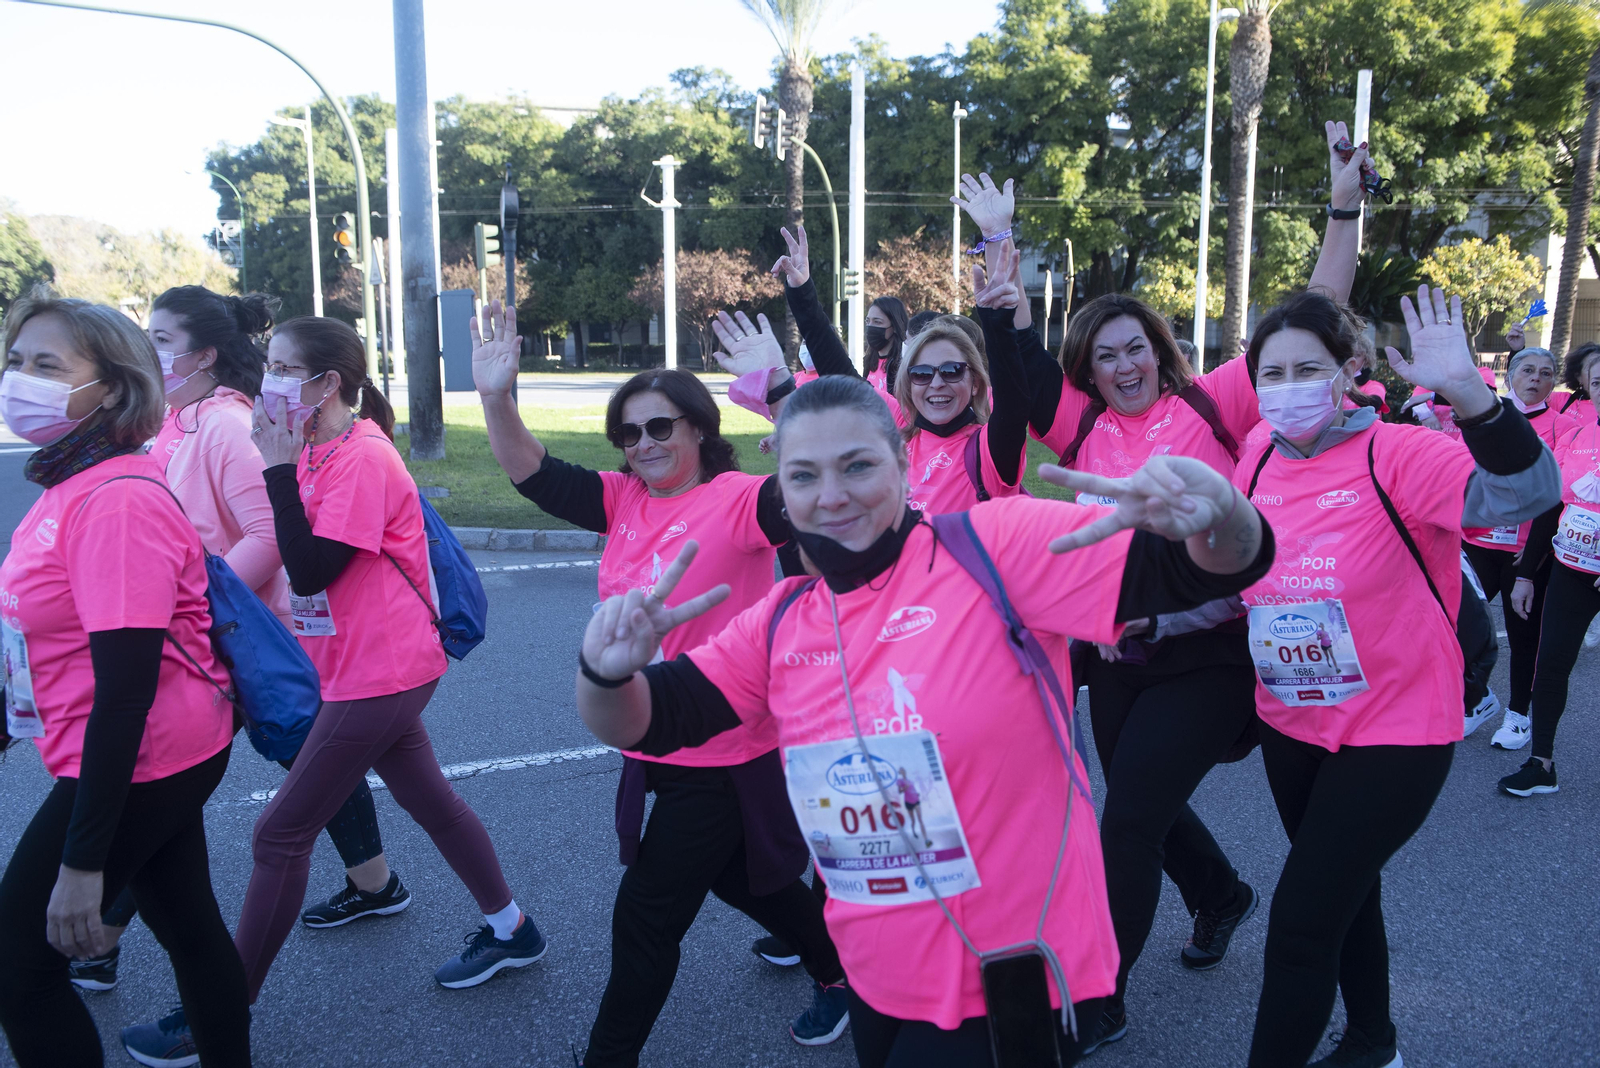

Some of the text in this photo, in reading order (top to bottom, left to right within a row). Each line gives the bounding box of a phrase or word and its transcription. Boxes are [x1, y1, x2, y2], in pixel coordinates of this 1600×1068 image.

[1250, 494, 1282, 506] OYSHO
[1566, 528, 1592, 545] 016
[1301, 557, 1336, 570] POR
[1281, 576, 1335, 590] TODAS
[641, 585, 656, 597] PO
[1273, 623, 1315, 634] ASTURIANA
[784, 651, 841, 667] OYSH
[1278, 644, 1323, 664] 016
[1293, 667, 1315, 677] 1686
[1320, 676, 1343, 684] MUJER
[873, 713, 924, 735] POR
[840, 801, 906, 835] 016
[859, 840, 891, 856] 2277
[835, 857, 871, 870] CARRERA
[873, 857, 886, 869] DE
[886, 856, 900, 868] LA
